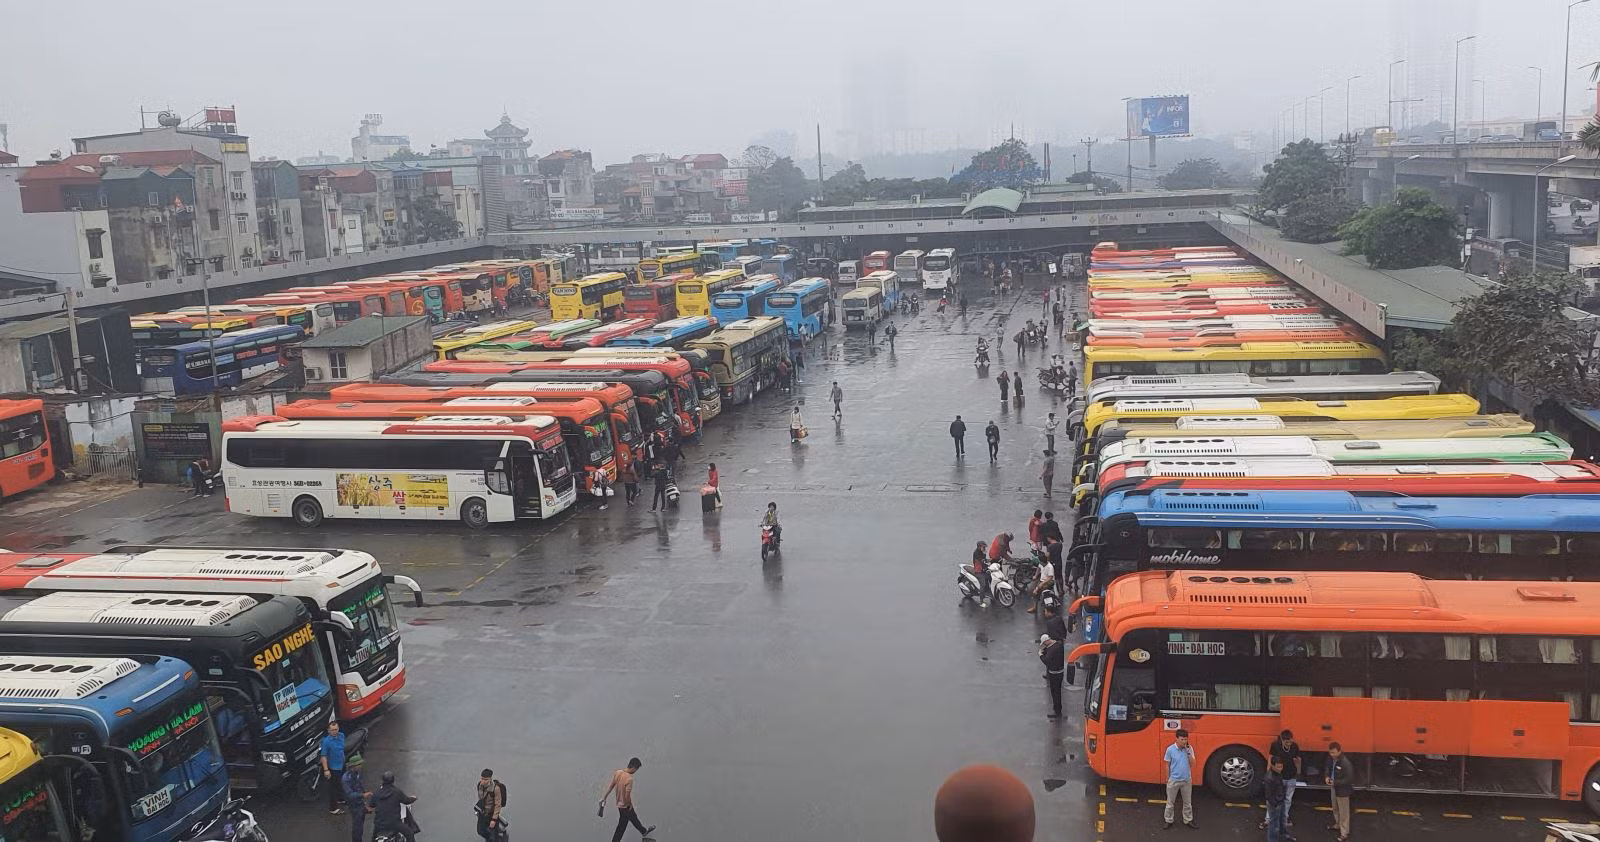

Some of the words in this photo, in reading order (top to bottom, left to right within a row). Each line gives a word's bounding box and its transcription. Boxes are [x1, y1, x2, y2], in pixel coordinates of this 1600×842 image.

[1150, 549, 1221, 565] mobihome
[253, 643, 283, 671] SAO
[144, 790, 168, 808] VINH
